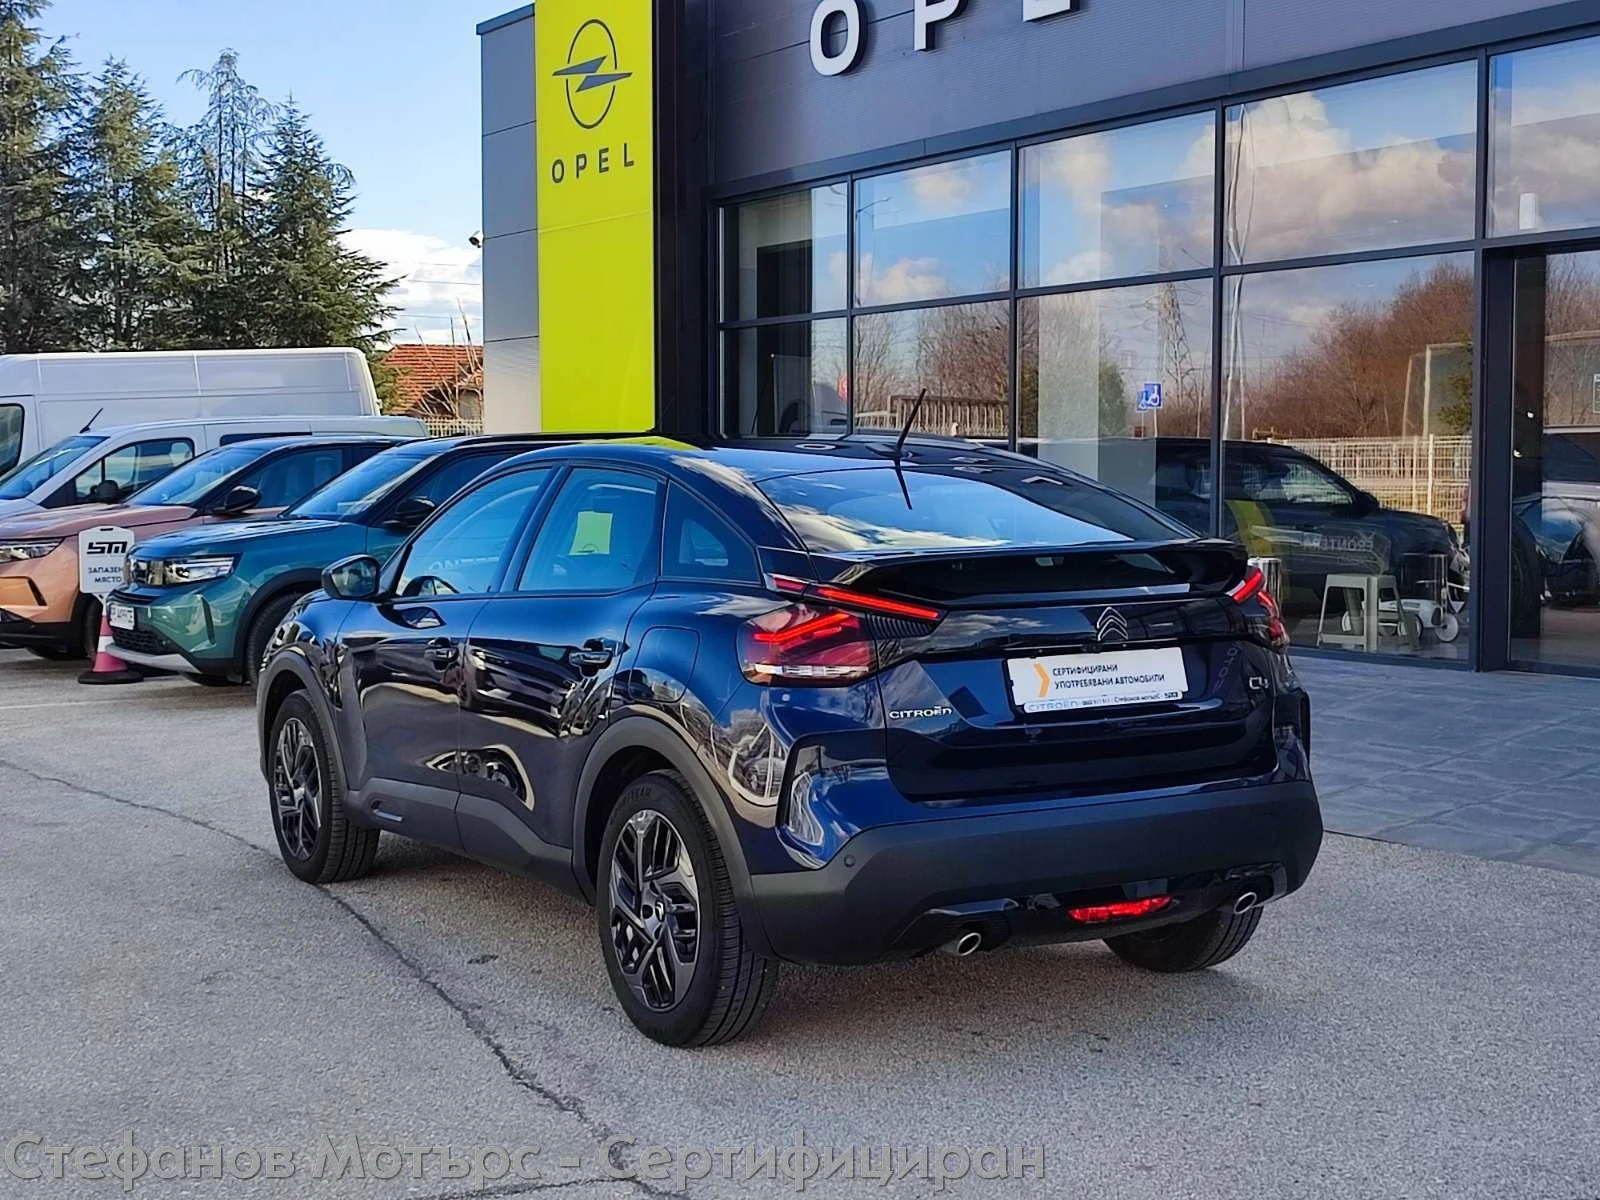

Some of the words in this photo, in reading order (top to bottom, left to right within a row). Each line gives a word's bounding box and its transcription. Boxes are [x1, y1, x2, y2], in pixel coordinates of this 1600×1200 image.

[810, 0, 1071, 76] OP
[551, 143, 635, 184] OPEL
[1052, 664, 1118, 677] СЕРТИФИЦИРАНИ
[1054, 678, 1114, 690] УПОТРЕБЯВАНИ
[1115, 673, 1166, 685] АВТОМОБИЛИ
